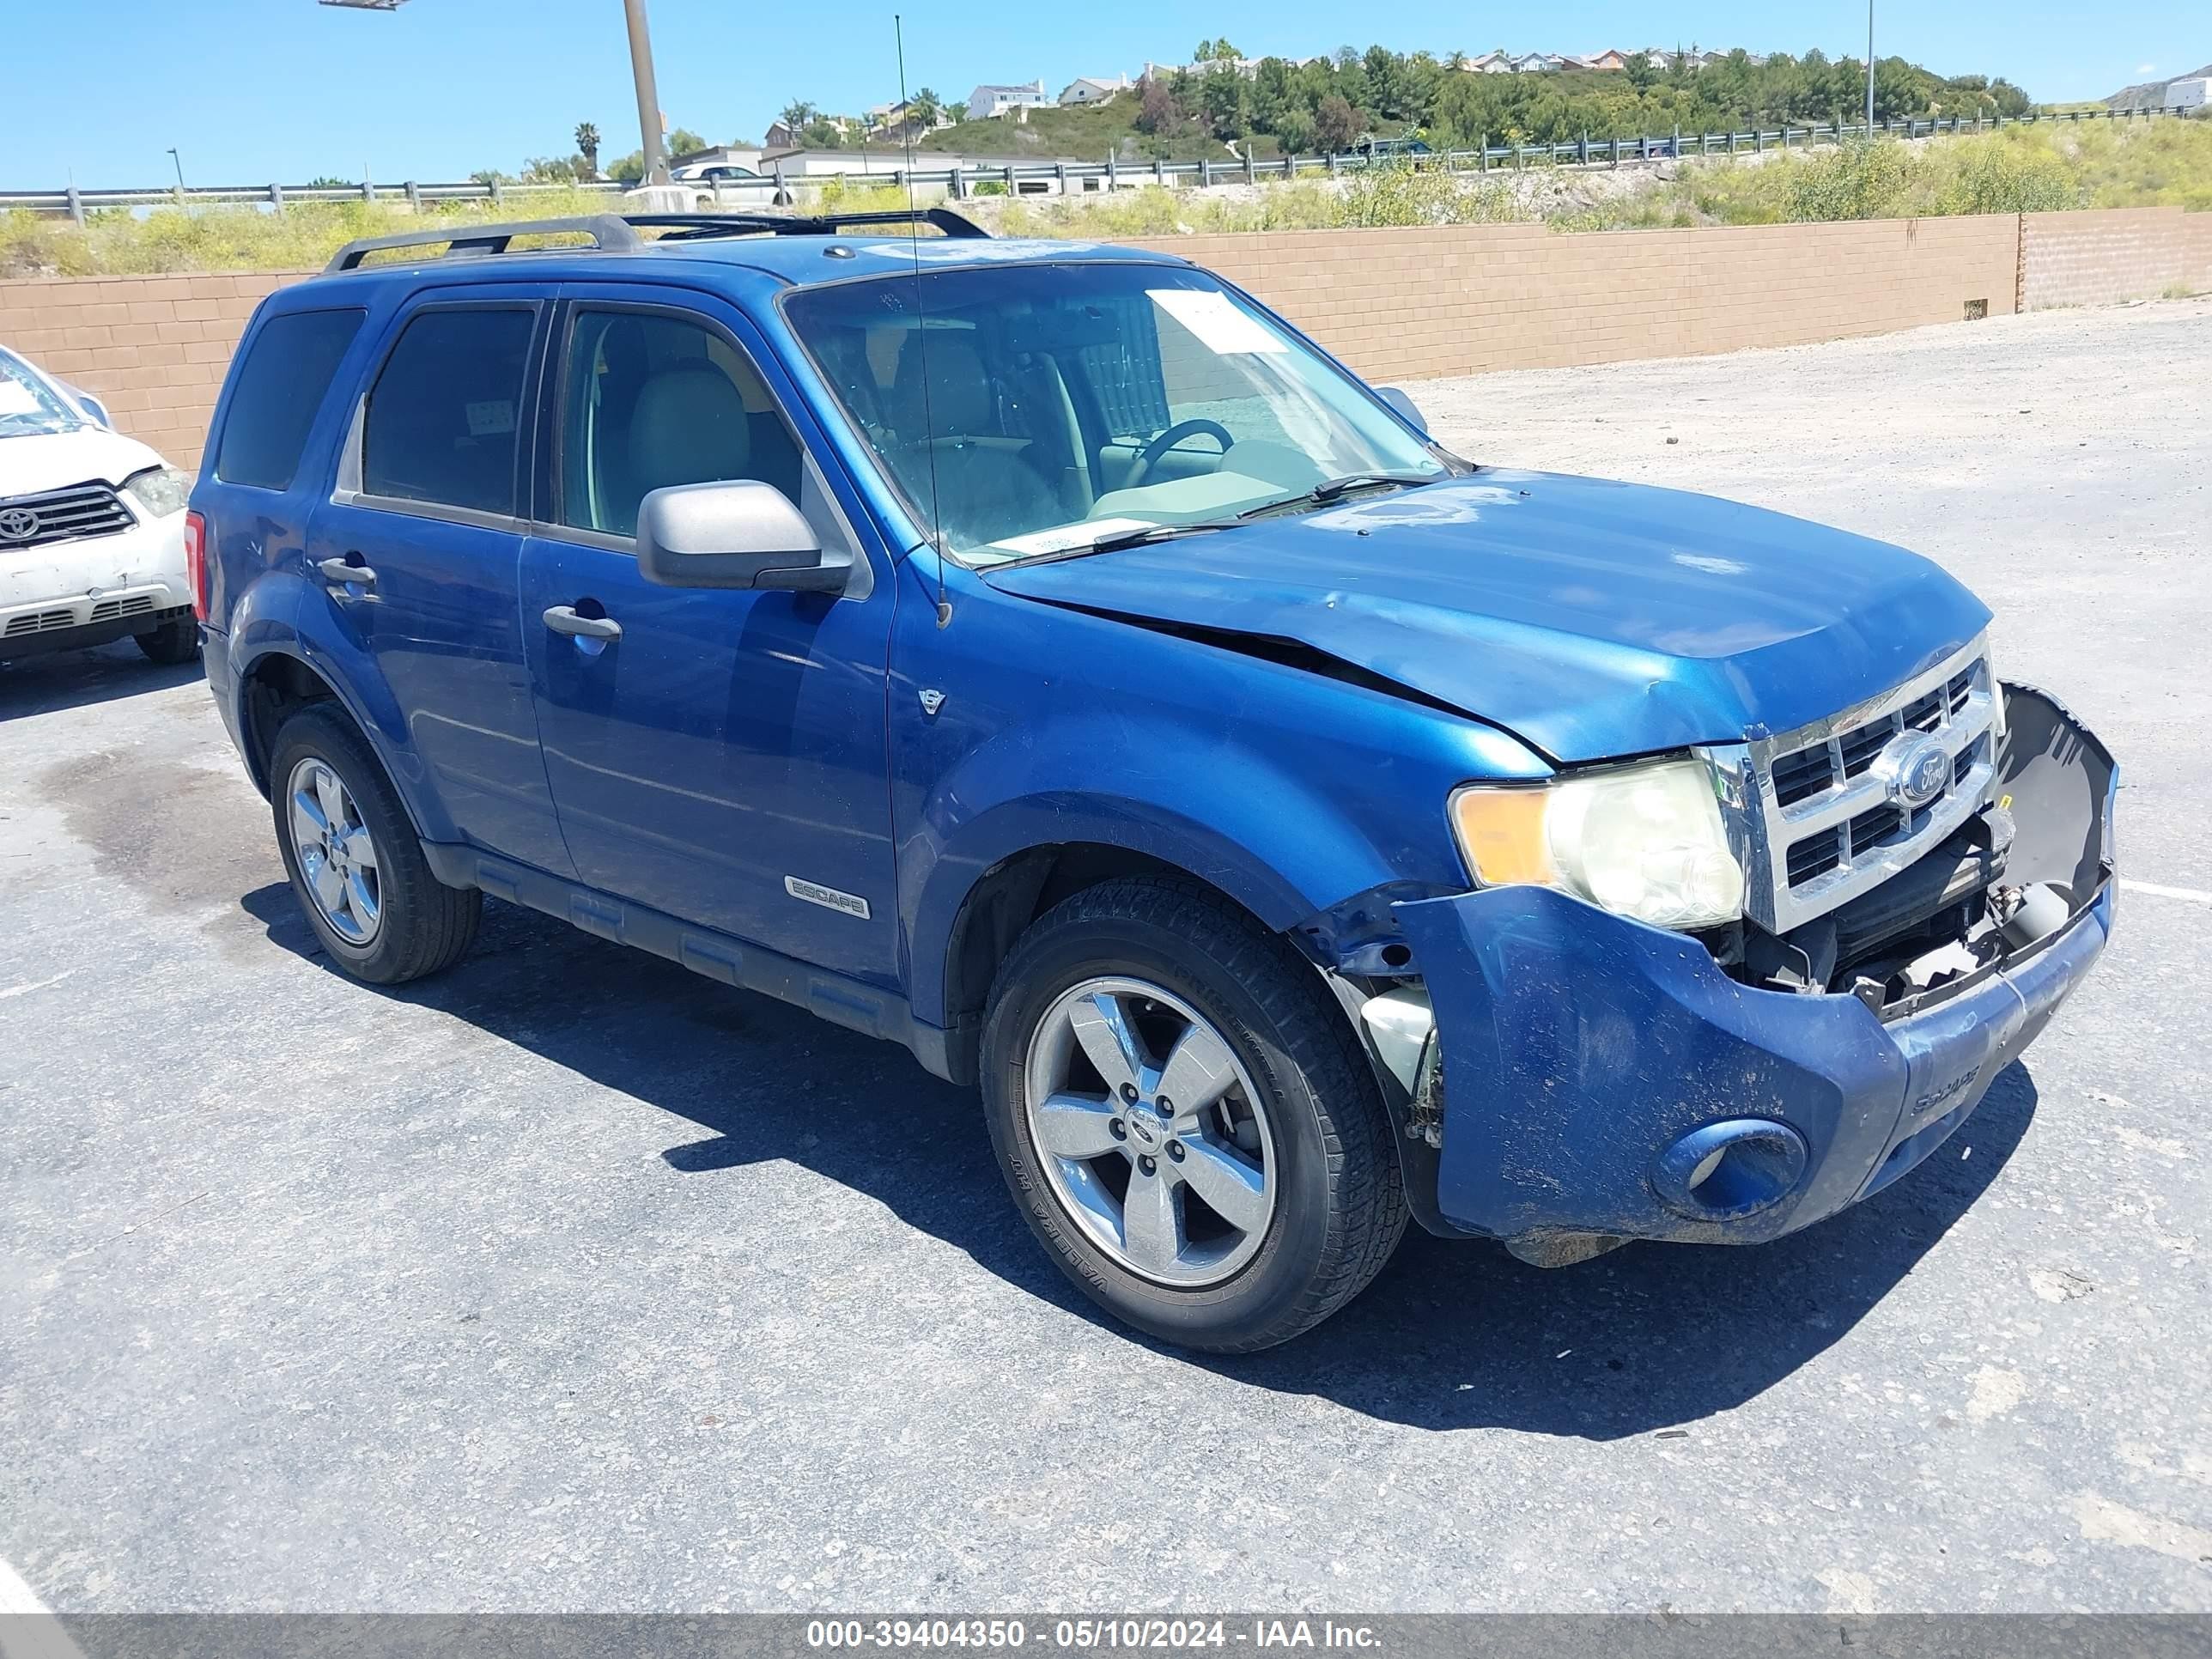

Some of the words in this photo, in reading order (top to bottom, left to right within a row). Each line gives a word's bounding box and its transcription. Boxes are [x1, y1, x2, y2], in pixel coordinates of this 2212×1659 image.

[1922, 756, 1945, 790] Ford
[792, 879, 866, 915] ESCAPE
[1913, 1065, 1980, 1113] ESCAPE
[1008, 1153, 1032, 1191] HT
[1031, 1202, 1109, 1293] VALERA
